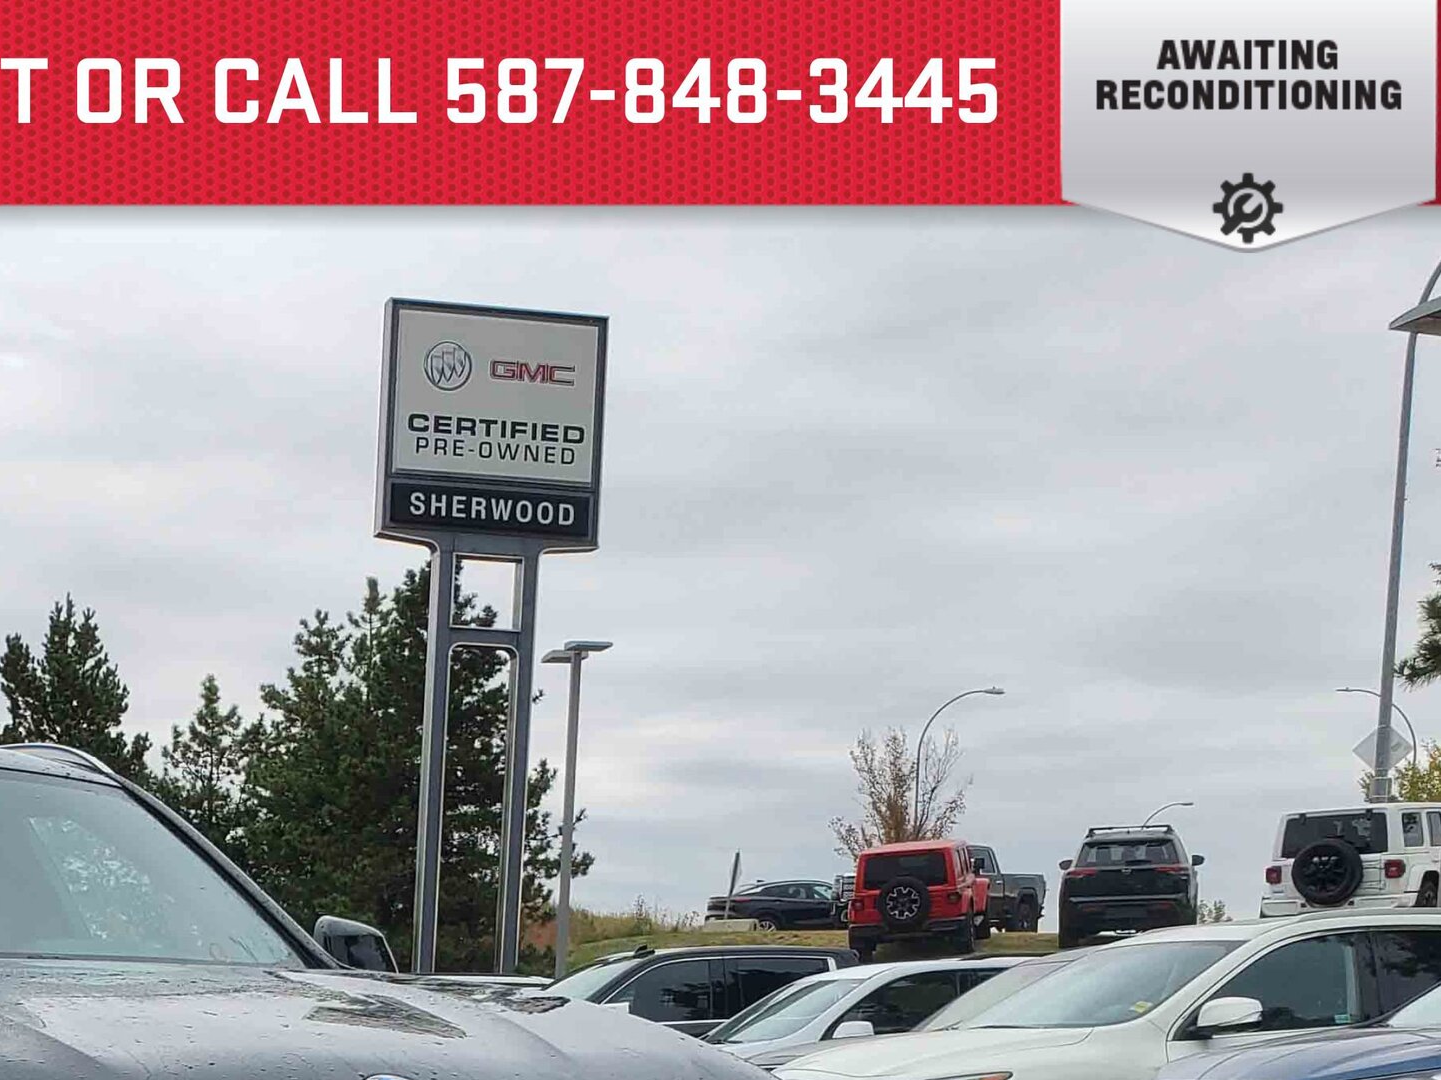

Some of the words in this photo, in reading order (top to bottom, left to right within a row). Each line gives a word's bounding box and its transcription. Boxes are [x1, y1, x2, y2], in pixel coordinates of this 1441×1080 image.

[490, 360, 576, 386] GMC
[408, 413, 585, 444] CERTIFIED
[415, 436, 575, 465] PRE-OWNED
[409, 492, 575, 526] SHERWOOD
